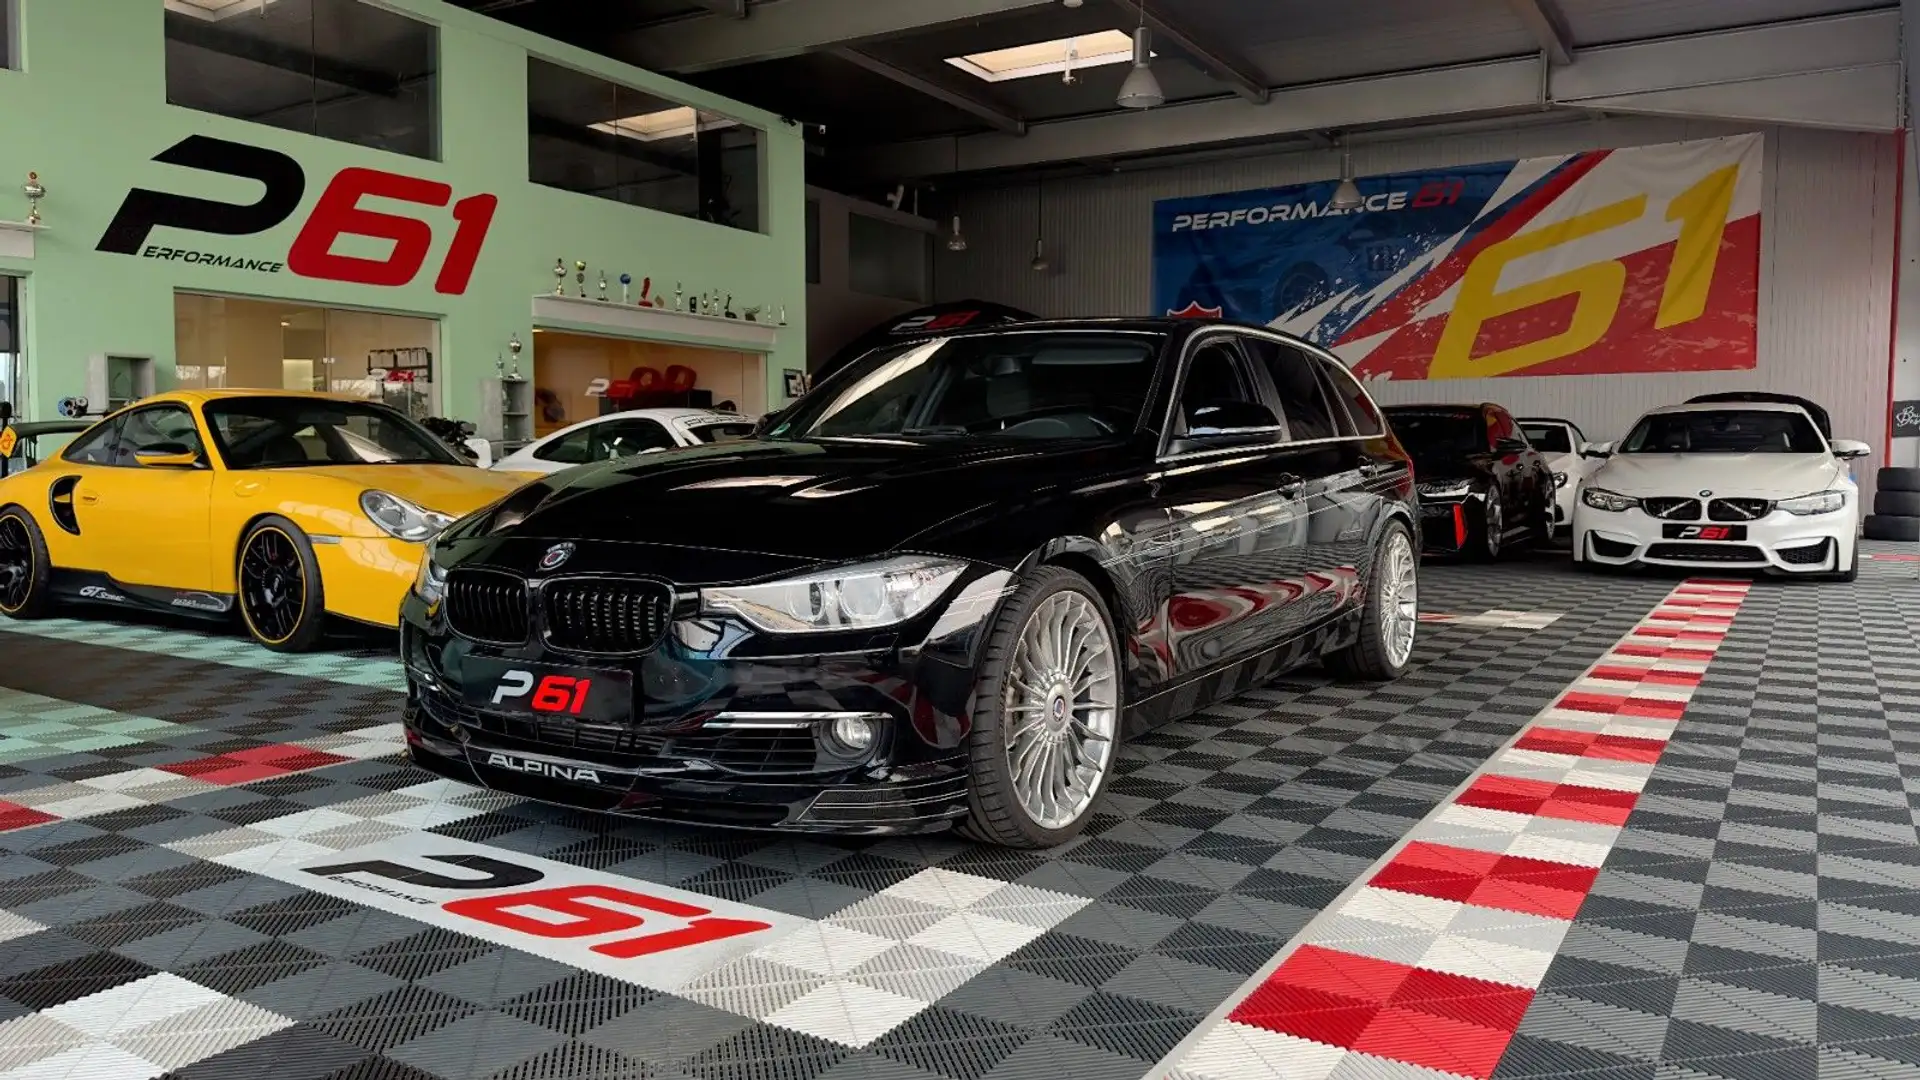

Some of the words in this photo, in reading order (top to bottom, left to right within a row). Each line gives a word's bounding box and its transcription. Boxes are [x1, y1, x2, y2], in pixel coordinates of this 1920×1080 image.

[95, 134, 498, 295] P61
[1411, 178, 1465, 209] 61
[1427, 163, 1739, 379] 61
[1678, 525, 1730, 540] P61
[491, 669, 592, 715] P61
[487, 753, 601, 784] ALPINA
[300, 854, 773, 958] P61
